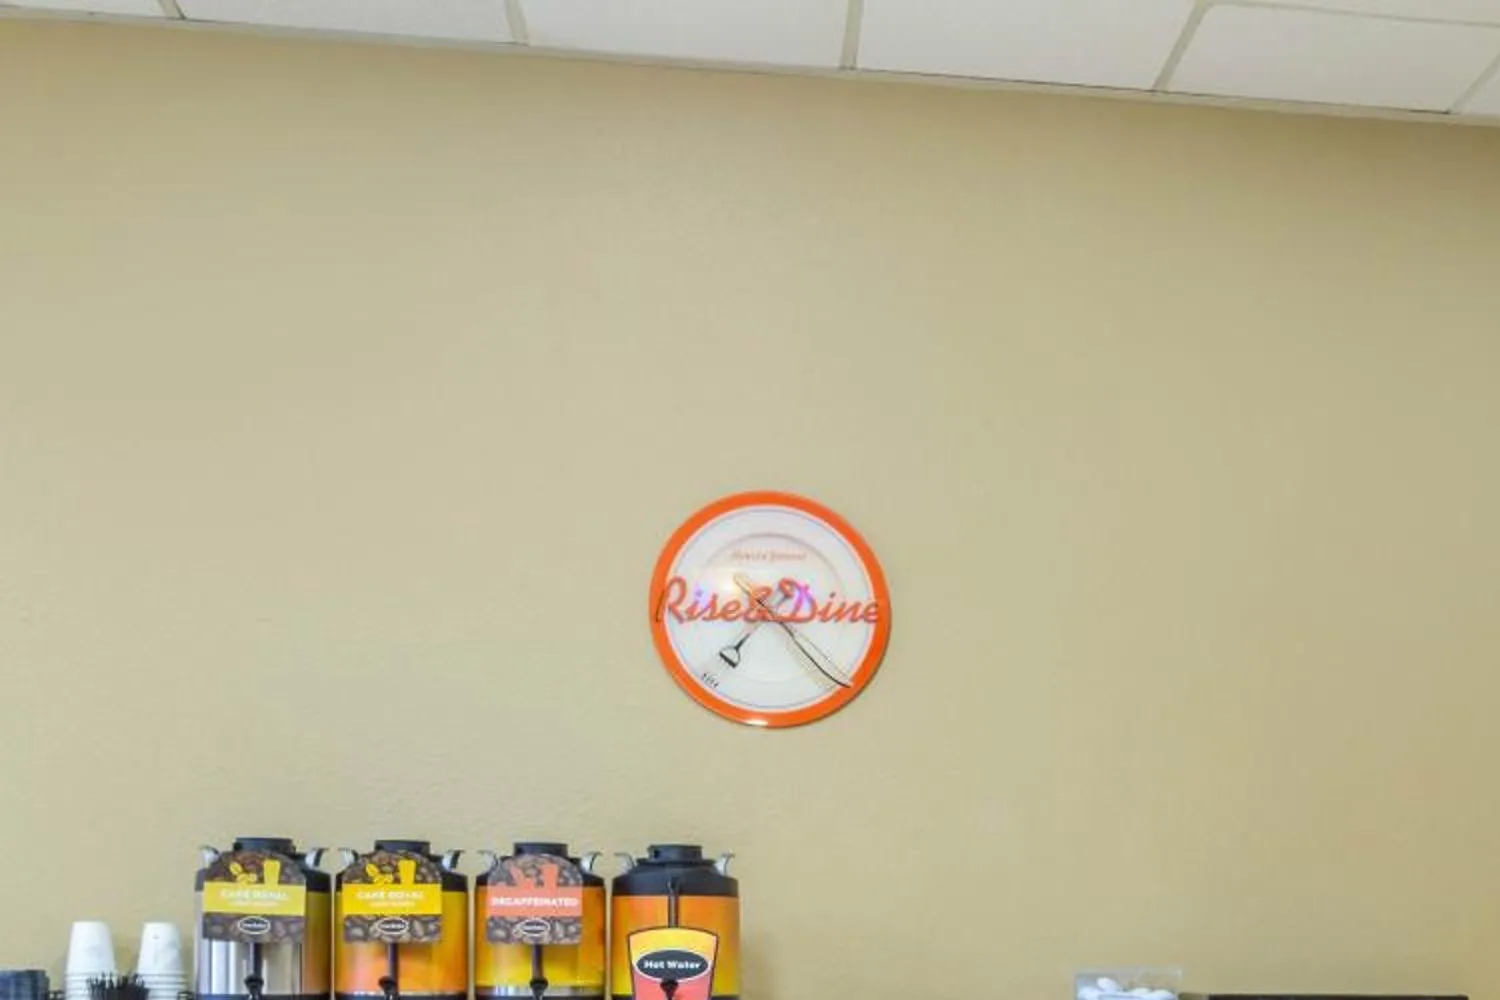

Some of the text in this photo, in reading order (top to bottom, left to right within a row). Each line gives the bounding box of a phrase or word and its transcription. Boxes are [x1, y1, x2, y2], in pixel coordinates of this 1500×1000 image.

[656, 576, 742, 625] Rise
[773, 577, 880, 624] Dine
[491, 896, 579, 907] DECAFFEINATED
[643, 959, 702, 969] Hot Water
